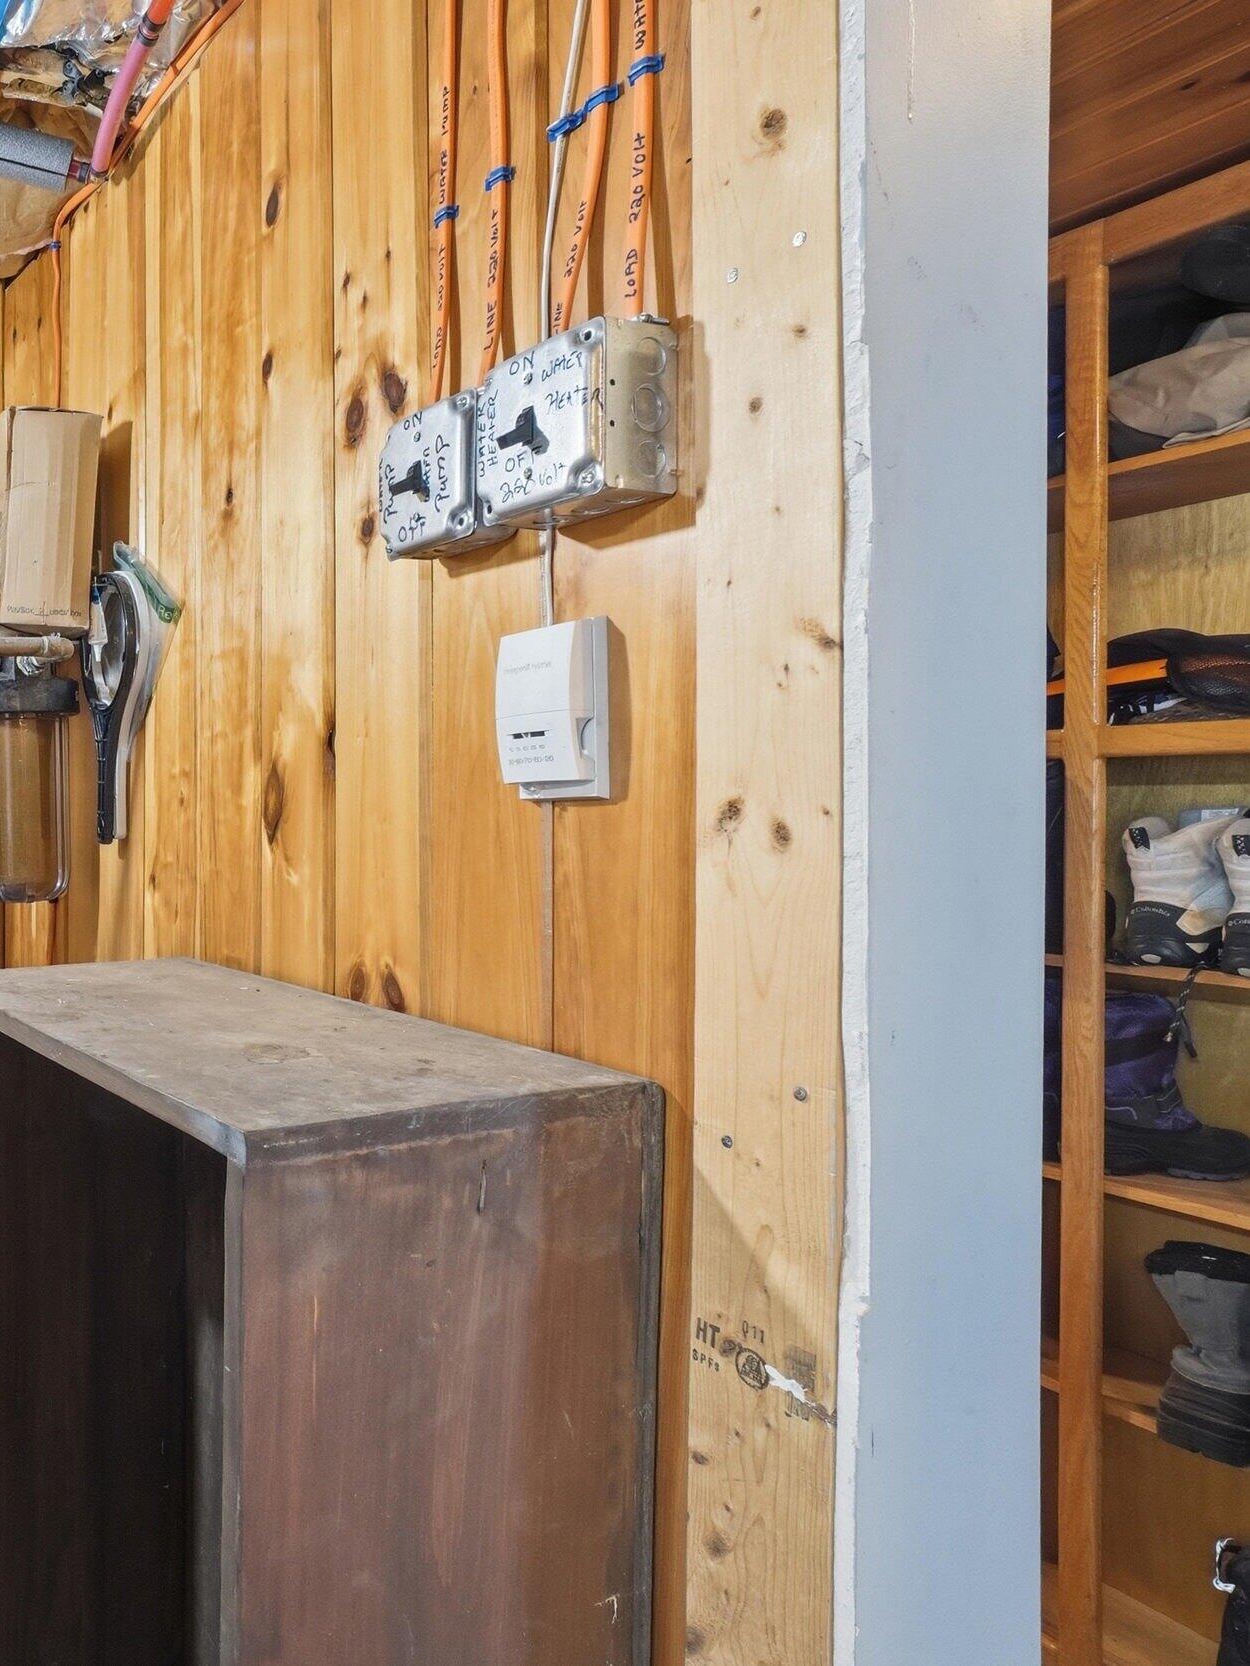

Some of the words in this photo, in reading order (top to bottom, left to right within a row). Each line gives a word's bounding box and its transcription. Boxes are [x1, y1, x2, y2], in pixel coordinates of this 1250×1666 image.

[629, 184, 646, 224] 220
[487, 251, 498, 288] 220
[564, 243, 578, 278] 220
[483, 300, 497, 351] LINE
[509, 350, 535, 376] ON
[403, 410, 423, 431] ON
[486, 389, 498, 467] HEATER
[477, 402, 487, 478] WATER
[695, 1317, 721, 1349] HT
